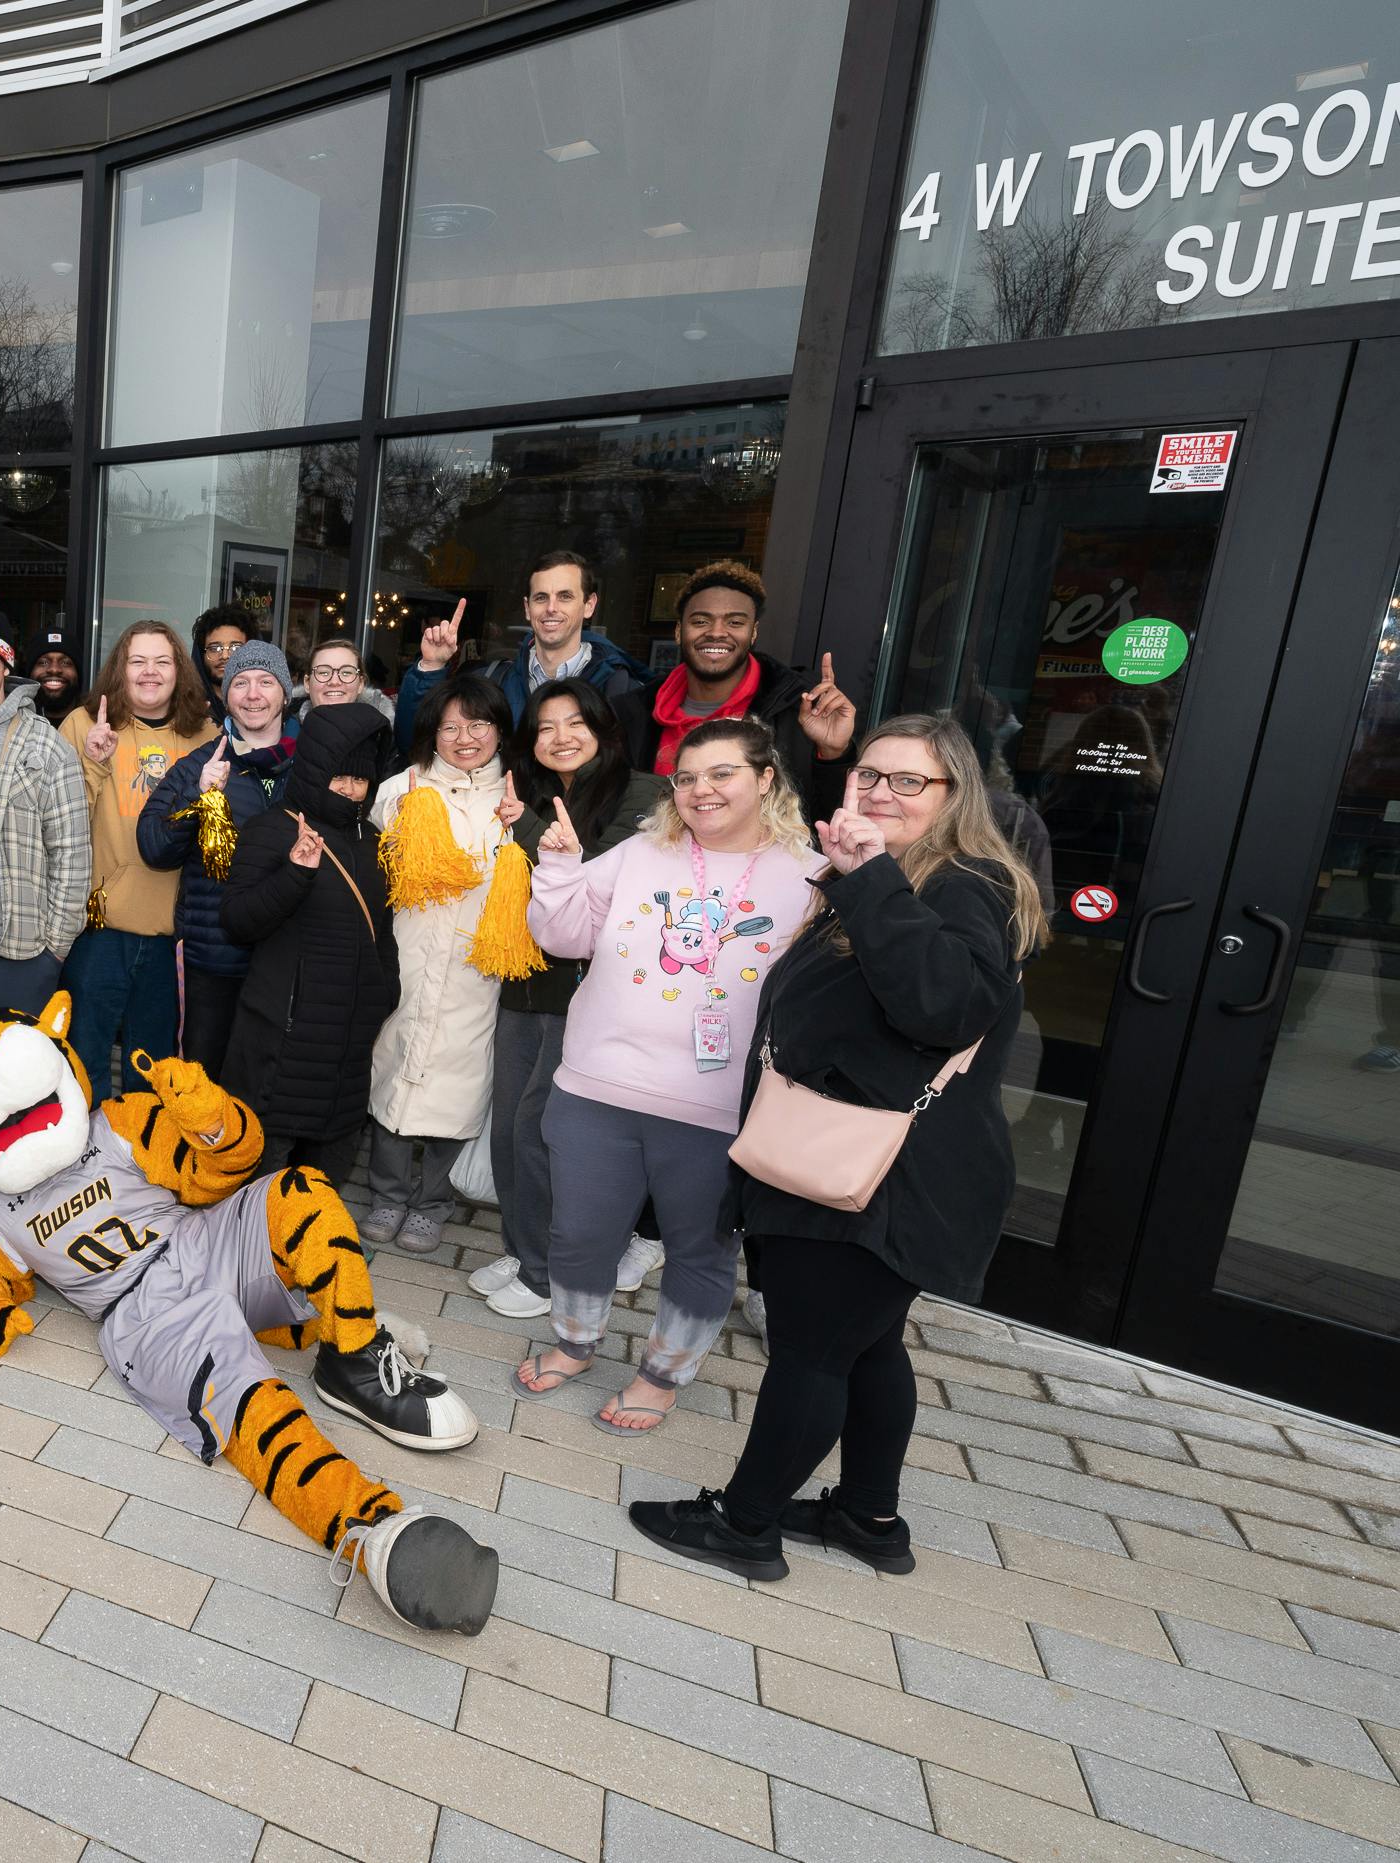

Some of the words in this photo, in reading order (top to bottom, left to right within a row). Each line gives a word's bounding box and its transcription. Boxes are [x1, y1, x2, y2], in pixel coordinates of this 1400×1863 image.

[899, 171, 941, 241] 4
[975, 151, 1043, 231] W
[1156, 196, 1400, 305] SUITE
[1168, 436, 1226, 450] SMILE
[1165, 453, 1221, 465] CAMERA
[1141, 625, 1172, 637] BEST
[1124, 636, 1169, 648] PLACES
[1131, 648, 1167, 659] WORK
[1097, 742, 1111, 750] Sun
[1116, 743, 1129, 751] Thu
[1076, 748, 1109, 757] 10:00am
[1114, 752, 1147, 760] 12:00am
[1075, 764, 1108, 773] 10:00am
[1112, 767, 1141, 775] 2:00am
[25, 1176, 113, 1248] TOWSON
[67, 1216, 160, 1274] 02
